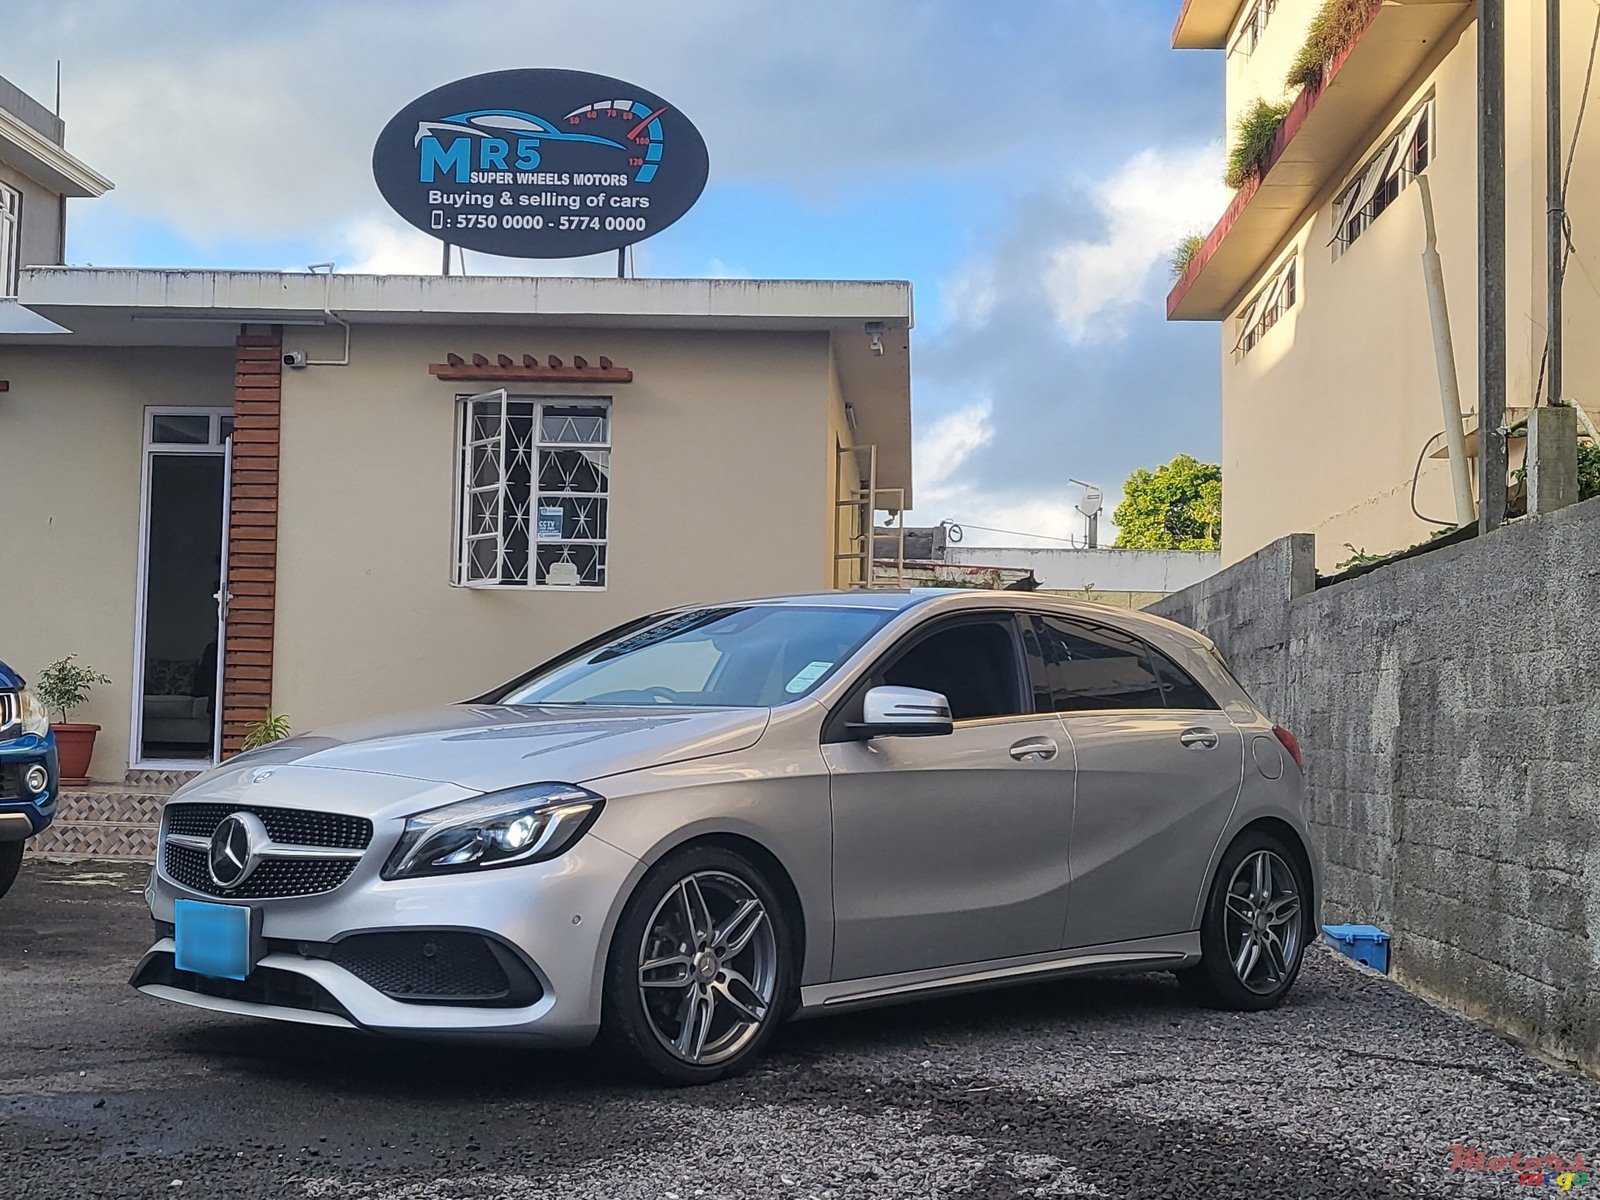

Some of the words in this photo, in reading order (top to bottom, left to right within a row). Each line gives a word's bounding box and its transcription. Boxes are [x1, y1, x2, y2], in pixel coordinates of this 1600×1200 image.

[607, 109, 617, 118] 70
[569, 116, 580, 125] 50
[635, 137, 650, 145] 100
[419, 136, 541, 183] MR5
[629, 158, 643, 166] 120
[470, 171, 513, 185] SUPER
[516, 172, 570, 185] WHEELS
[573, 173, 628, 186] MOTORS
[428, 190, 494, 208] Buying
[499, 191, 514, 206] &
[519, 192, 580, 210] selling
[586, 193, 606, 207] of
[610, 196, 650, 208] cars
[456, 214, 498, 229] 5750
[502, 215, 543, 230] 0000
[558, 216, 600, 230] 5774
[605, 216, 646, 231] 0000
